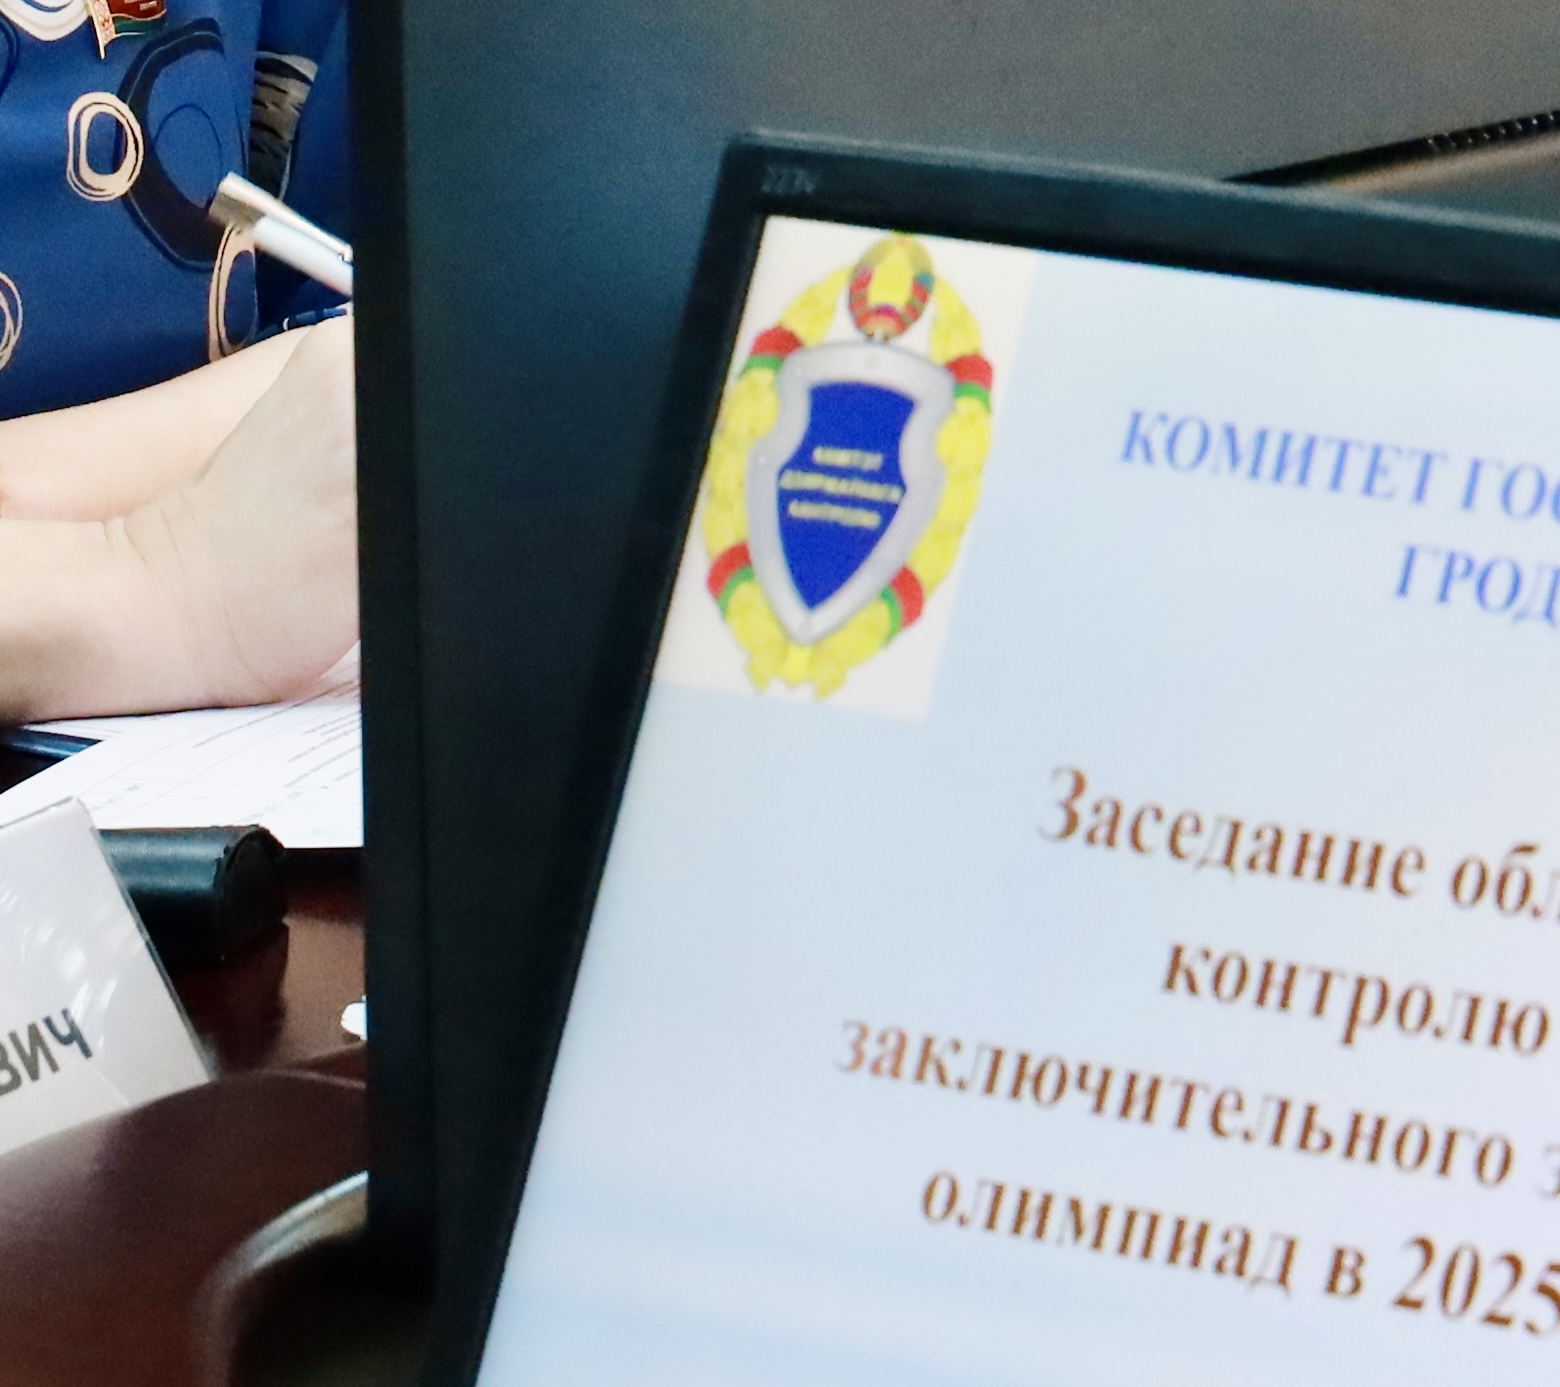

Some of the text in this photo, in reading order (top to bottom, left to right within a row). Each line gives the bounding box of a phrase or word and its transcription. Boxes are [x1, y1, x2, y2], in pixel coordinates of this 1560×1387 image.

[1118, 409, 1448, 507] КОМИТЕТ
[1038, 766, 1428, 900] Заседание
[1161, 941, 1552, 1049] контролю
[837, 1020, 1515, 1187] заключительного
[920, 1169, 1302, 1297] олимпиад
[1323, 1243, 1370, 1301] в
